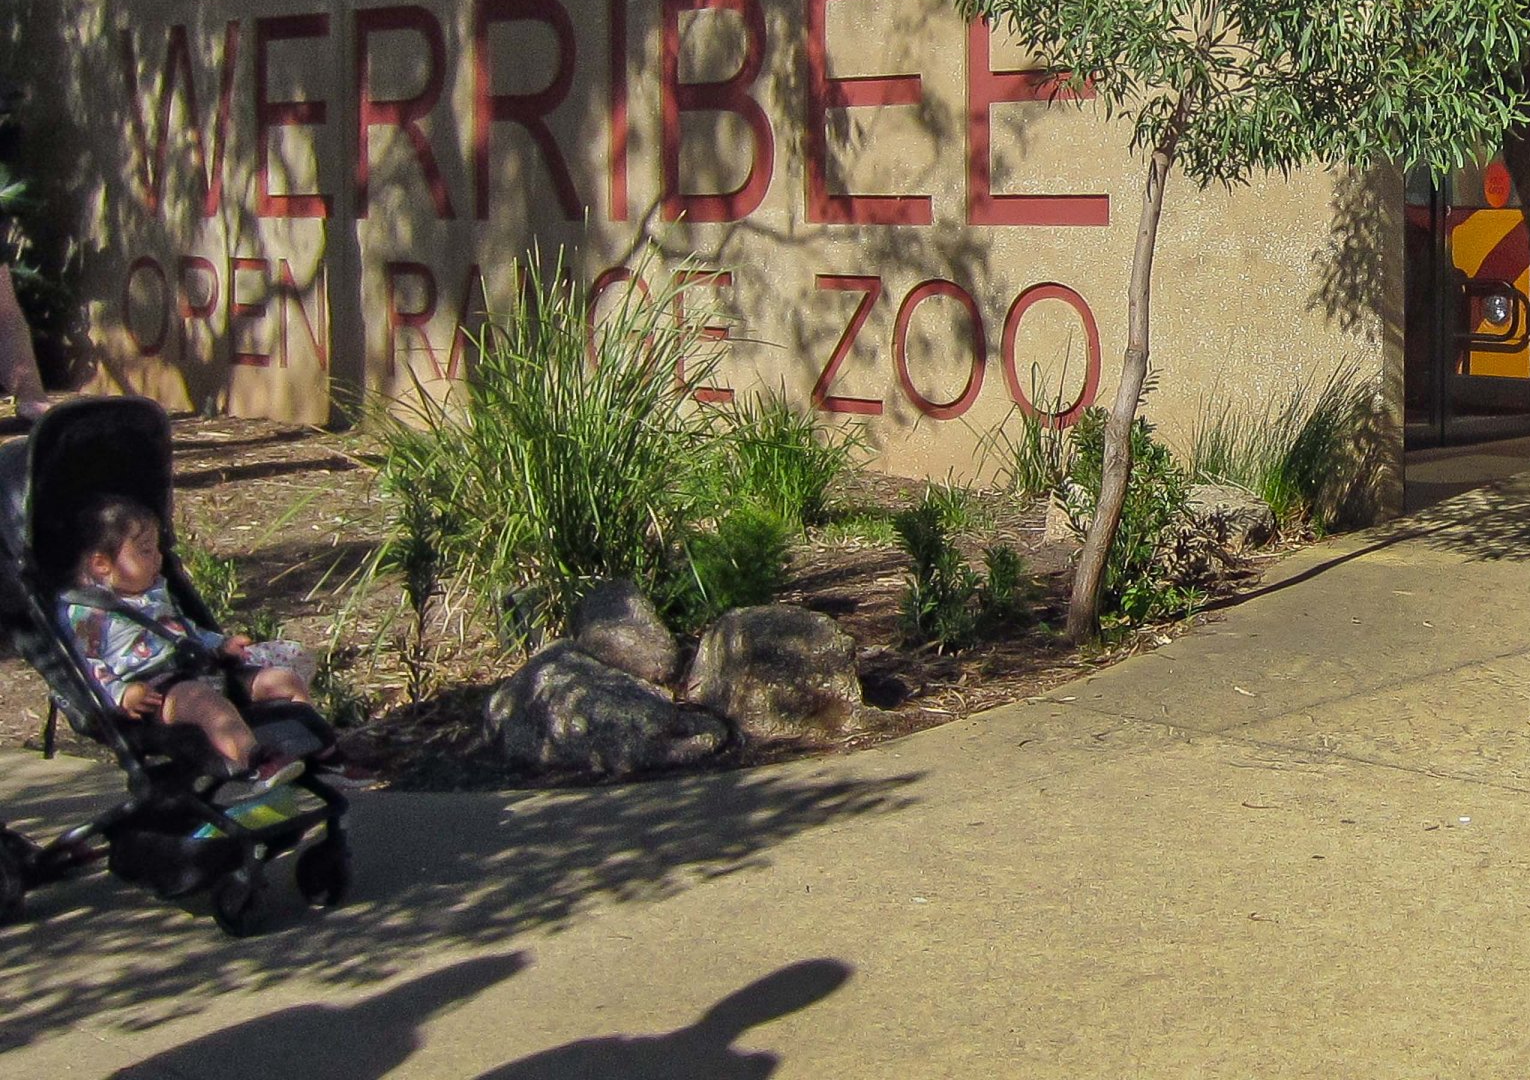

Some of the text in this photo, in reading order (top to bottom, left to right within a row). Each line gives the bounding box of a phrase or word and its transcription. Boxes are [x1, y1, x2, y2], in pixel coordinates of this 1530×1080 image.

[121, 255, 1101, 430] OPEN RAGE ZOO
